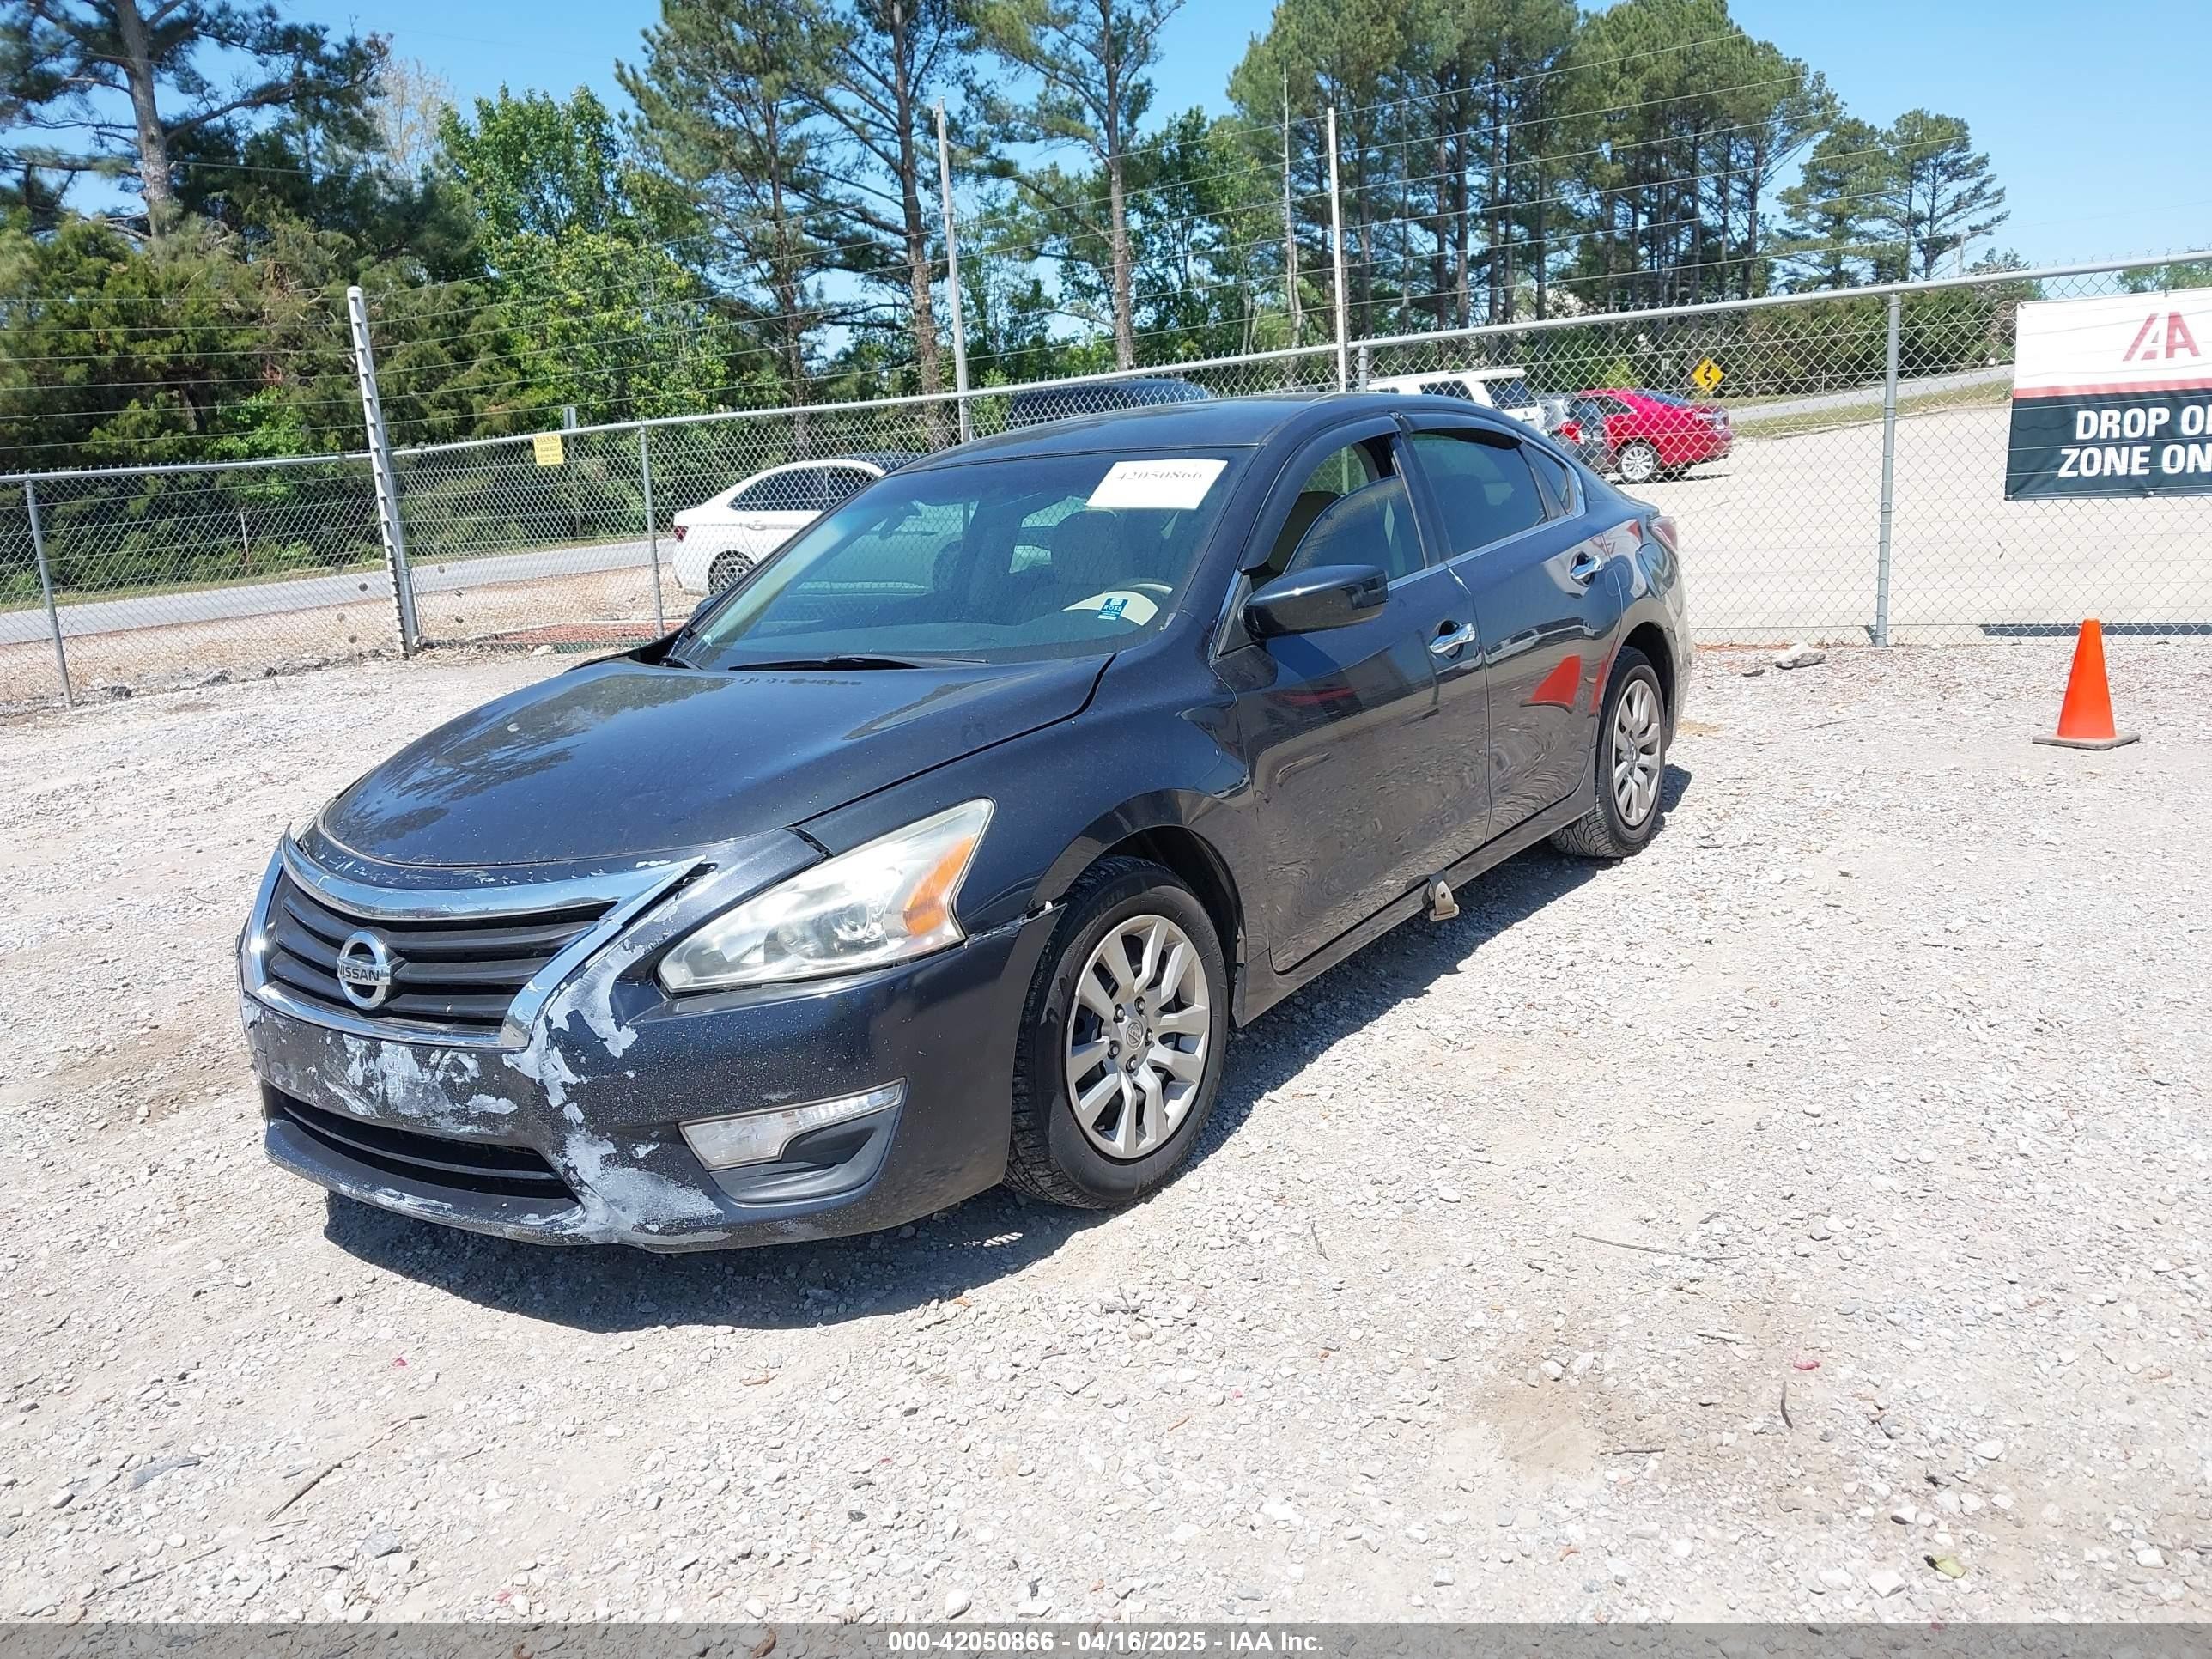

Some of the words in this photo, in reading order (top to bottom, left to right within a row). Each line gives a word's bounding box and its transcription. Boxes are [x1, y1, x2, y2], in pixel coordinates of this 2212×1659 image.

[2075, 407, 2171, 440] DROP
[2057, 446, 2152, 477] ZONE
[337, 963, 380, 982] NISSAN
